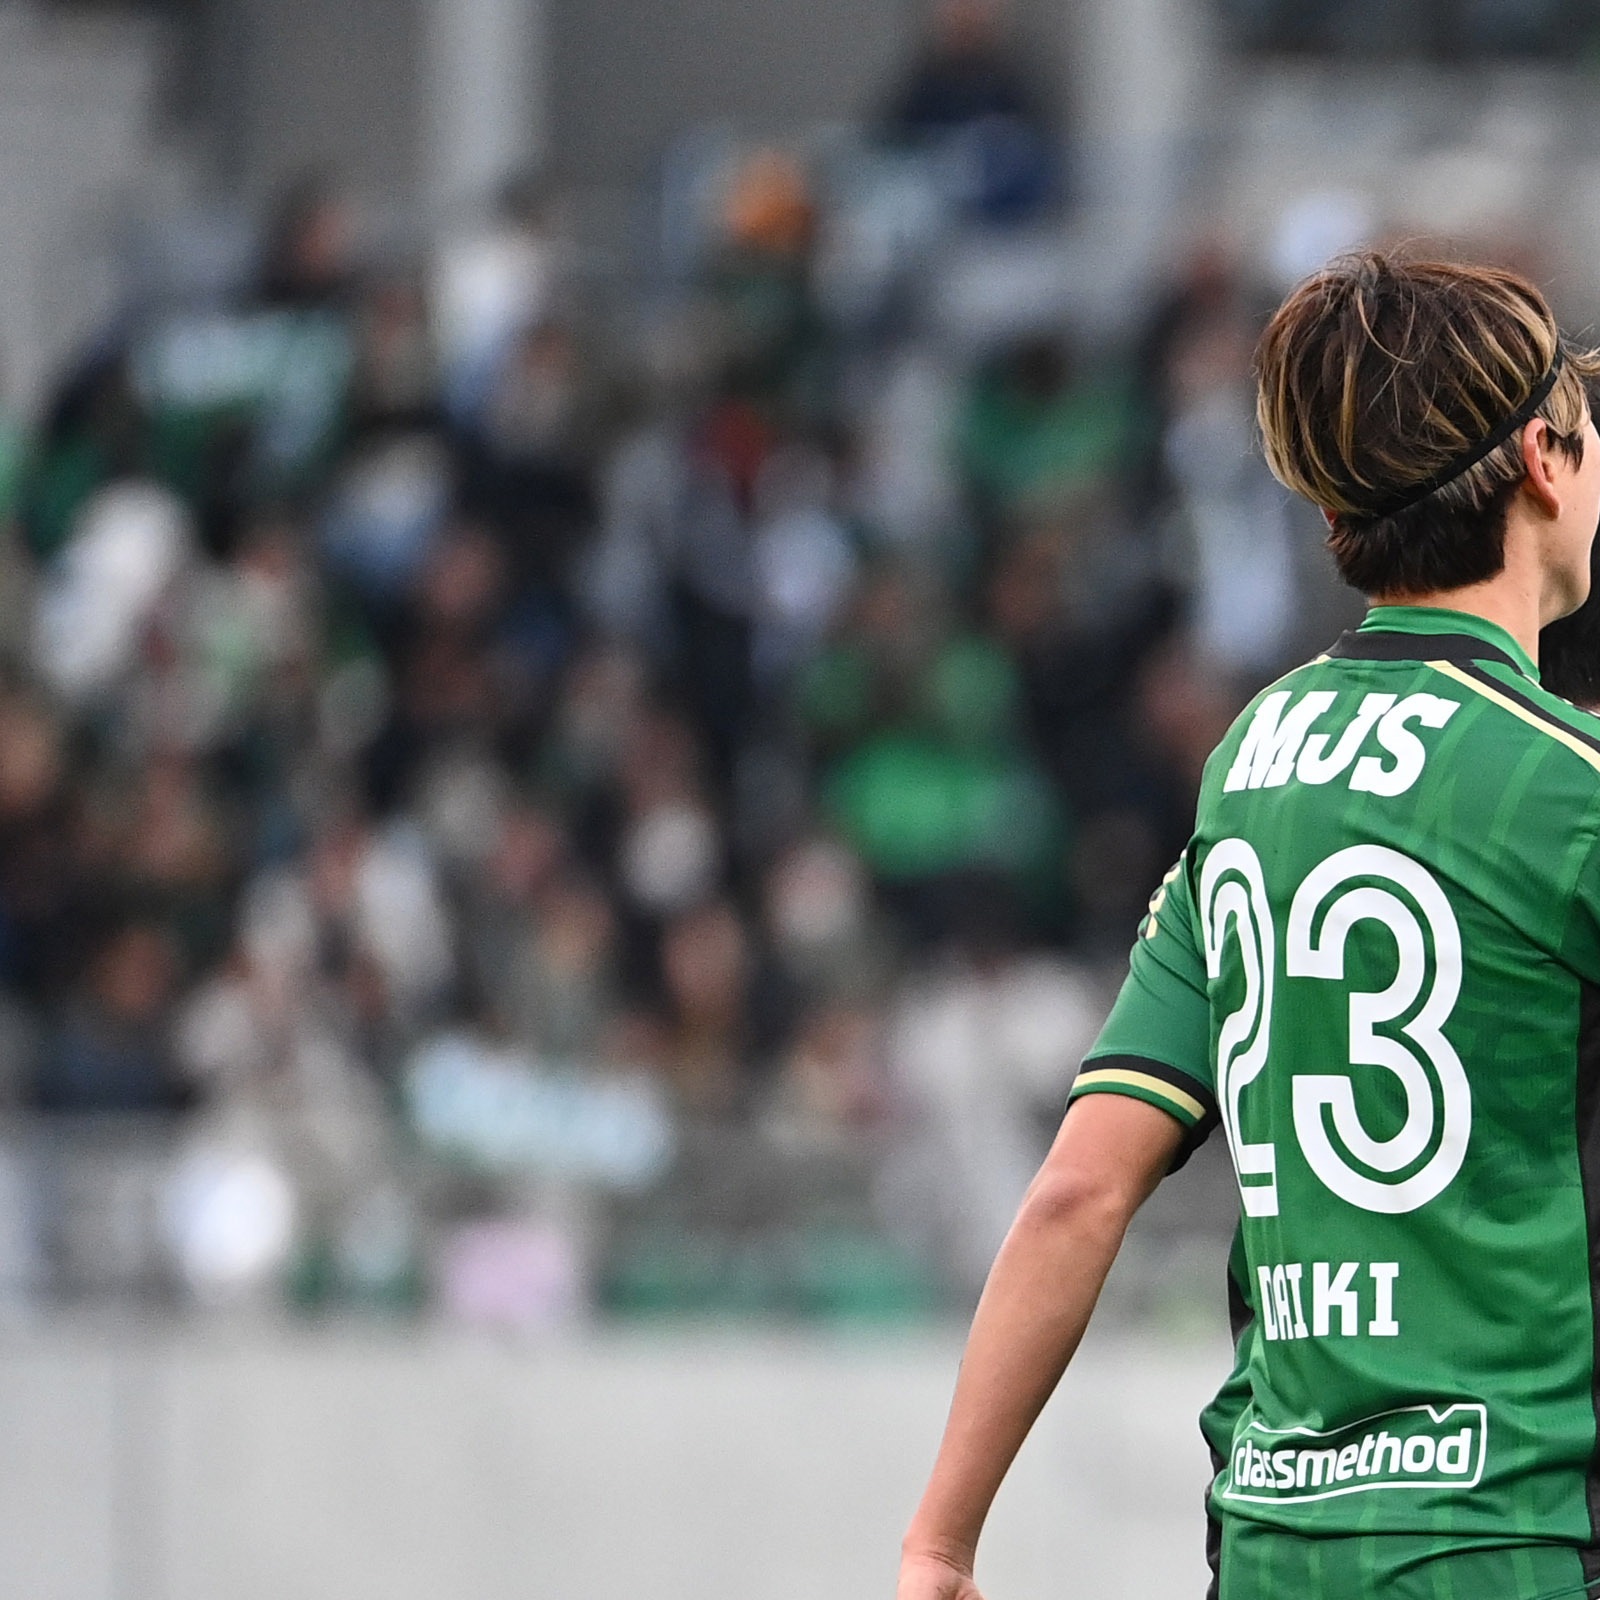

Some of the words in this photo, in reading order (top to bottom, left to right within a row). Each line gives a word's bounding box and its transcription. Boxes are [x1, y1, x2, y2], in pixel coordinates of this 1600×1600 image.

[1223, 691, 1461, 797] MJS
[1200, 838, 1471, 1217] 23
[1257, 1262, 1399, 1340] DAIKI
[1235, 1428, 1472, 1489] classmethod
